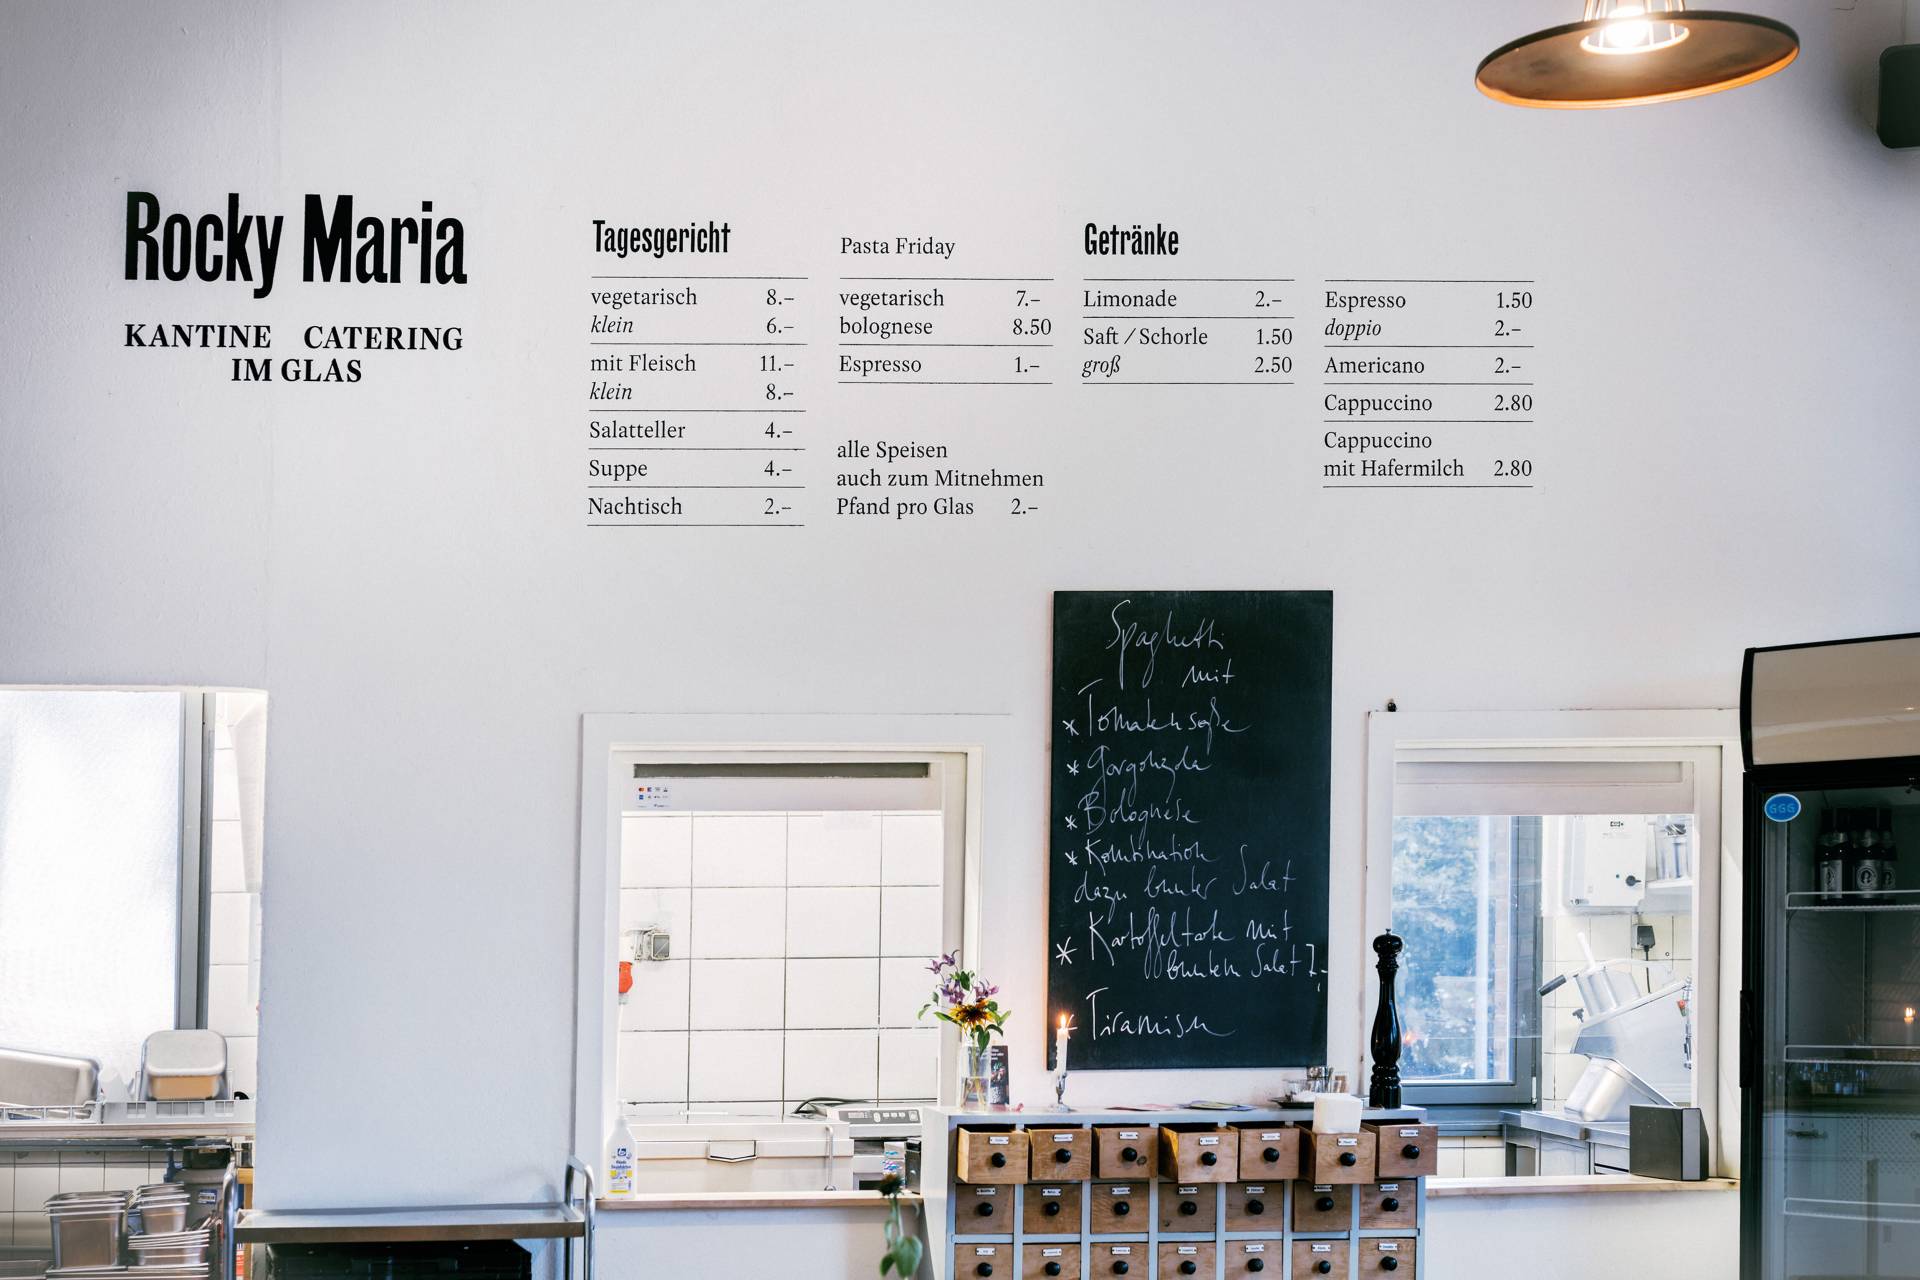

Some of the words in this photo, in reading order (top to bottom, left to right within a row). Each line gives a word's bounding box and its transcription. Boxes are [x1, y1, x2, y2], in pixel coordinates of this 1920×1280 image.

[124, 191, 284, 299] Rocky
[302, 193, 468, 286] Maria
[592, 219, 732, 260] Tagesgericht
[840, 237, 891, 255] Pasta
[895, 235, 956, 260] Friday
[1084, 222, 1180, 256] Getränke
[590, 286, 698, 311] vegetarisch
[839, 287, 945, 312] vegetarisch
[1083, 288, 1177, 308] Limonade
[1324, 290, 1407, 313] Espresso
[1496, 291, 1533, 309] 1.50
[590, 314, 634, 334] klein
[839, 315, 933, 340] bolognese
[1012, 318, 1052, 336] 8.50
[1083, 325, 1120, 345] Saft
[1139, 326, 1208, 345] Schorle
[1256, 327, 1293, 346] 1.50
[1324, 317, 1382, 341] doppio
[123, 323, 271, 349] KANTINE
[303, 325, 464, 351] CATERING
[231, 358, 273, 382] IM
[280, 357, 362, 383] GLAS
[590, 354, 624, 372] mit
[628, 352, 697, 372] Fleisch
[839, 354, 922, 378] Espresso
[1081, 354, 1121, 379] groß
[1254, 356, 1293, 374] 2.50
[1324, 356, 1425, 374] Americano
[589, 381, 633, 401] klein
[1324, 393, 1433, 416] Cappuccino
[1493, 394, 1533, 412] 2.80
[589, 419, 686, 439] Salatteller
[837, 439, 870, 459] alle
[876, 440, 948, 464] Speisen
[1323, 431, 1433, 454] Cappuccino
[589, 459, 648, 482] Suppe
[836, 467, 882, 487] auch
[887, 473, 929, 487] zum
[934, 468, 1045, 487] Mitnehmen
[1323, 459, 1356, 477] mit
[1360, 457, 1465, 477] Hafermilch
[1493, 459, 1533, 477] 2.80
[587, 495, 683, 515] Nachtisch
[836, 495, 891, 516] Pfand
[896, 502, 928, 520] pro
[933, 496, 974, 515] Glas
